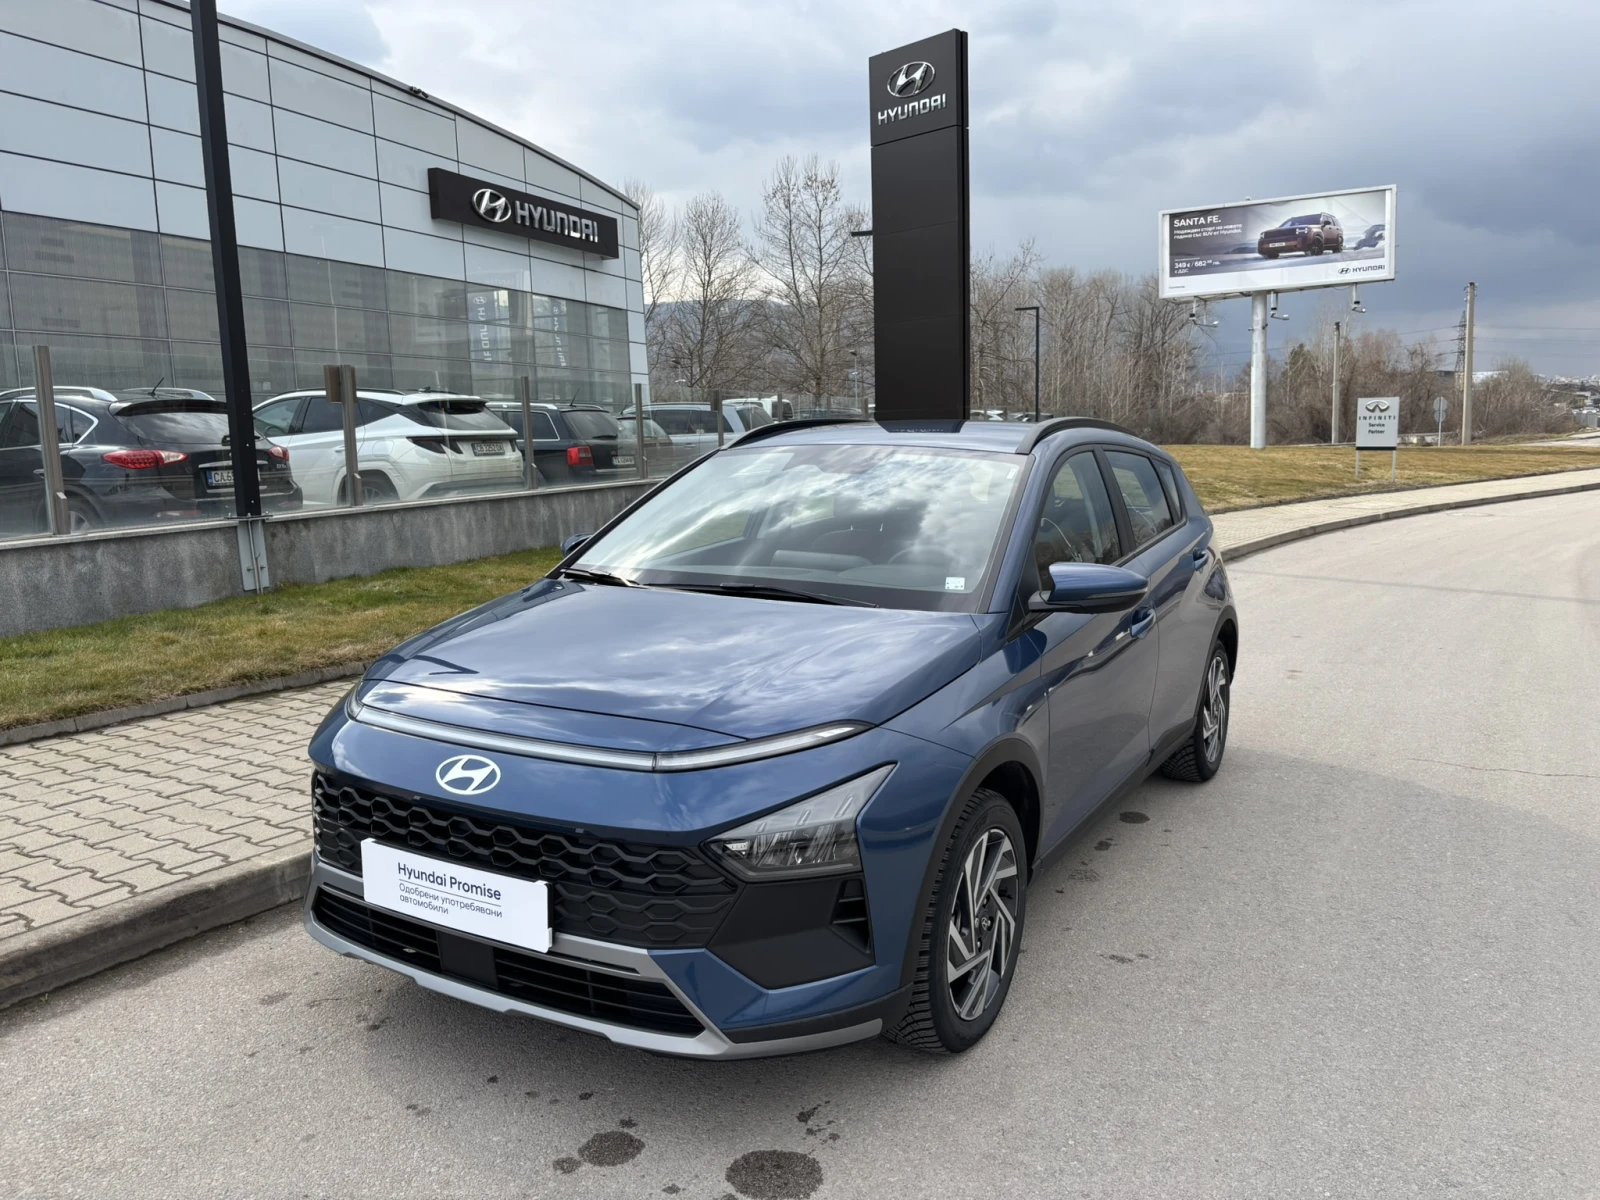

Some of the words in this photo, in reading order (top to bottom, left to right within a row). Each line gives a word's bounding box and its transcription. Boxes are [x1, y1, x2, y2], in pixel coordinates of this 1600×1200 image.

[878, 93, 946, 125] HYUNDAI
[514, 200, 598, 243] HYUNDAI
[1174, 217, 1206, 227] SANTA
[1207, 216, 1221, 224] FE.
[1352, 264, 1386, 273] HYUNDAI
[398, 862, 447, 887] Hyundai
[449, 876, 502, 900] Promise
[399, 882, 440, 901] Одобрени
[440, 895, 503, 918] употребявани
[400, 894, 449, 915] автомобили
